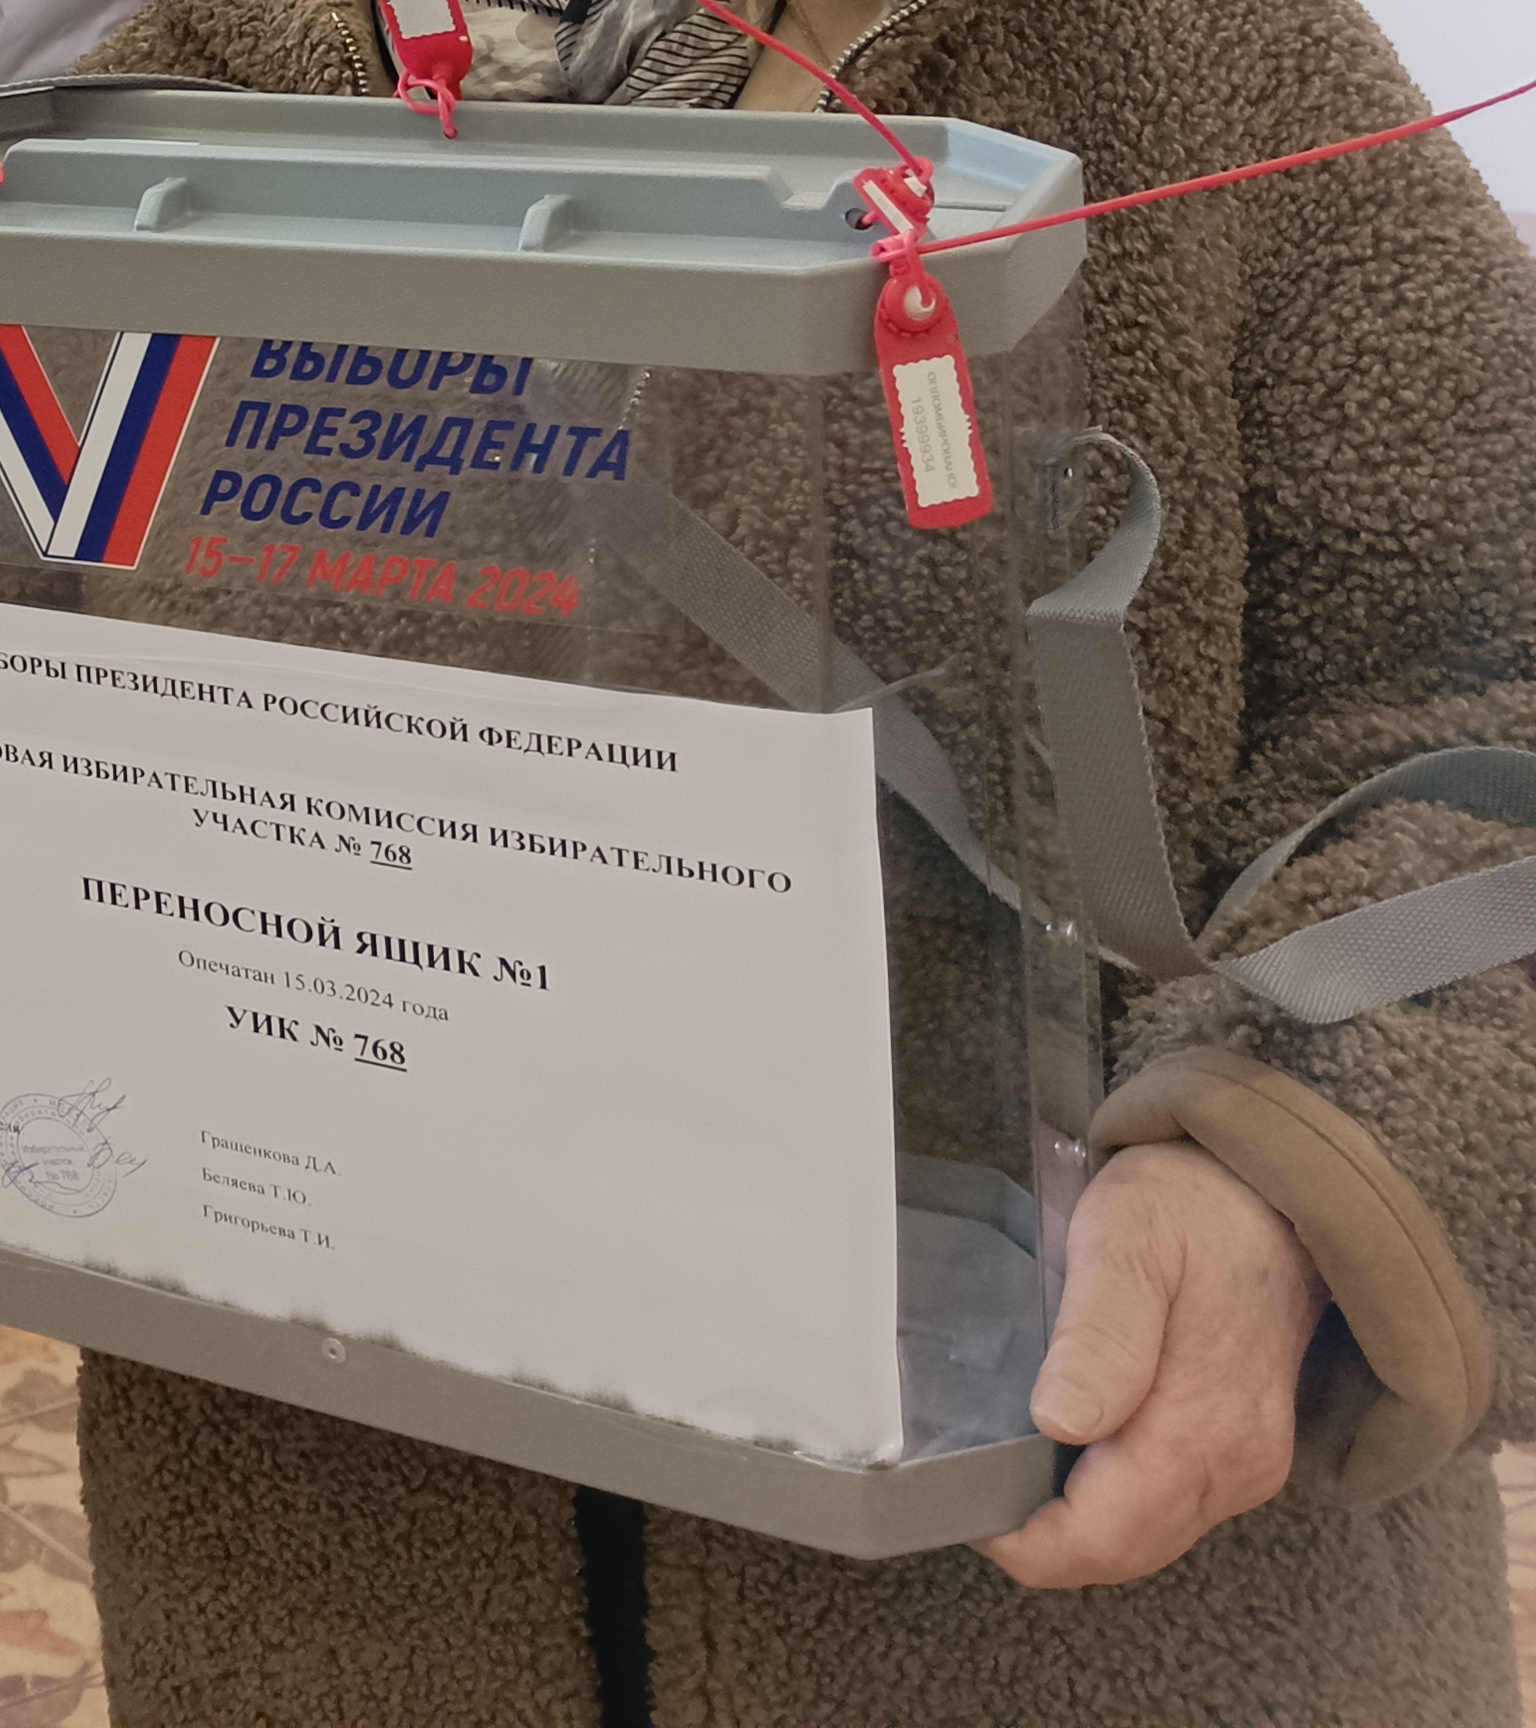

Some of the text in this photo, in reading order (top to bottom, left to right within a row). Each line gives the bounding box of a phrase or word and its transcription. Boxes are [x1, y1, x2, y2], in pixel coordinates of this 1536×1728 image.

[250, 338, 534, 396] ВЫБОРЫ
[224, 399, 633, 482] ПРЕЗИДЕНТА
[911, 397, 936, 474] 19399934
[199, 469, 452, 539] РОССИИ
[307, 547, 458, 606] МАРТА
[467, 564, 582, 619] 2024
[75, 663, 254, 710] ПРЕЗИДЕНТА
[262, 692, 470, 743] РОССИЙСКОЙ
[478, 725, 679, 772] ФЕДЕРАЦИИ
[61, 754, 296, 811] ИЗБИРАТЕЛЬНАЯ
[306, 796, 479, 844] КОМИССИЯ
[488, 826, 792, 893] ИЗБИРАТЕЛЬНОГО
[192, 808, 413, 867] УЧАСТКА № 768
[81, 876, 551, 991] ПЕРЕНОСНОЙ ЯЩИК №1
[178, 949, 450, 1022] Опечатан 15.03.2024 года
[225, 1004, 408, 1067] УИК № 768
[62, 1169, 81, 1182] 768
[202, 1167, 313, 1207] Беляева Т.Ю.
[304, 1155, 343, 1177] Д.А.
[202, 1204, 336, 1250] Григорьева Т.И.
